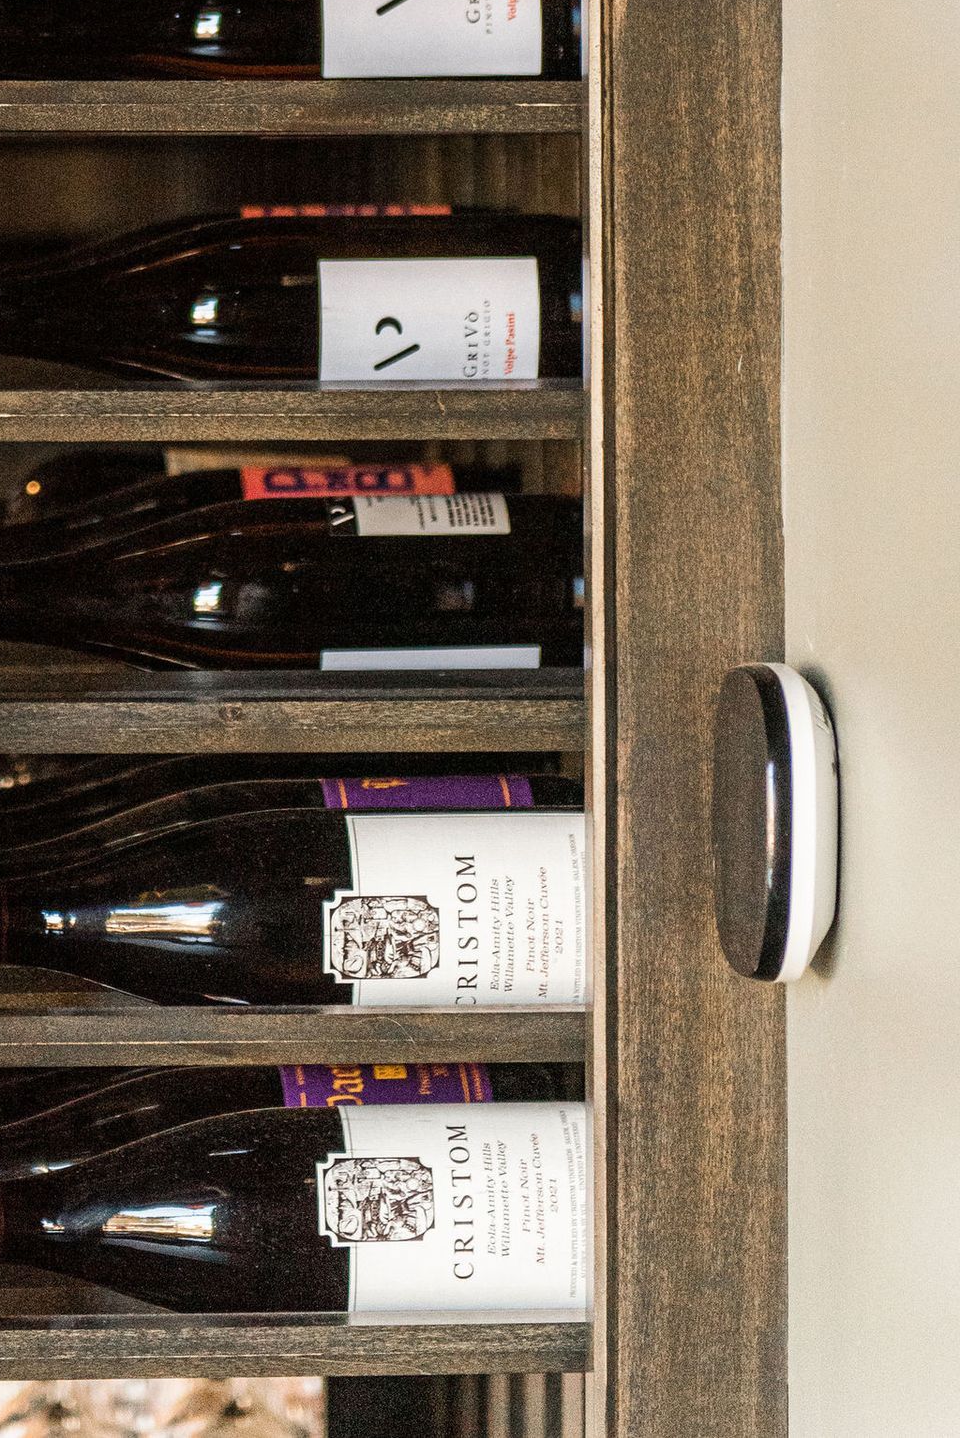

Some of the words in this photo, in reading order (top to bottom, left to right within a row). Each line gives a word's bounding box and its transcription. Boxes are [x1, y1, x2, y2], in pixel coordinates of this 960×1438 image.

[504, 312, 516, 346] Pasini
[504, 348, 517, 375] Volpe
[489, 878, 500, 912] Hills
[504, 875, 516, 918] Valley
[538, 866, 550, 910] Cuvée
[526, 898, 536, 932] Noir
[490, 916, 502, 991] Eola-Amity
[526, 936, 536, 972] Pinot
[540, 913, 550, 978] Jefferson
[554, 918, 564, 955] 2021
[504, 921, 515, 992] Willamette
[538, 980, 548, 998] Mt.
[482, 1142, 493, 1172] Hills
[496, 1139, 508, 1176] Valley
[530, 1132, 542, 1170] Cuvée
[519, 1157, 530, 1188] Noir
[445, 1124, 474, 1280] CRISTOM
[522, 1194, 532, 1233] Pinot
[534, 1171, 546, 1239] Jefferson
[549, 1178, 559, 1214] 2021
[486, 1175, 498, 1255] Eola-Amity
[500, 1180, 511, 1257] Willamette
[536, 1242, 546, 1265] Mt.
